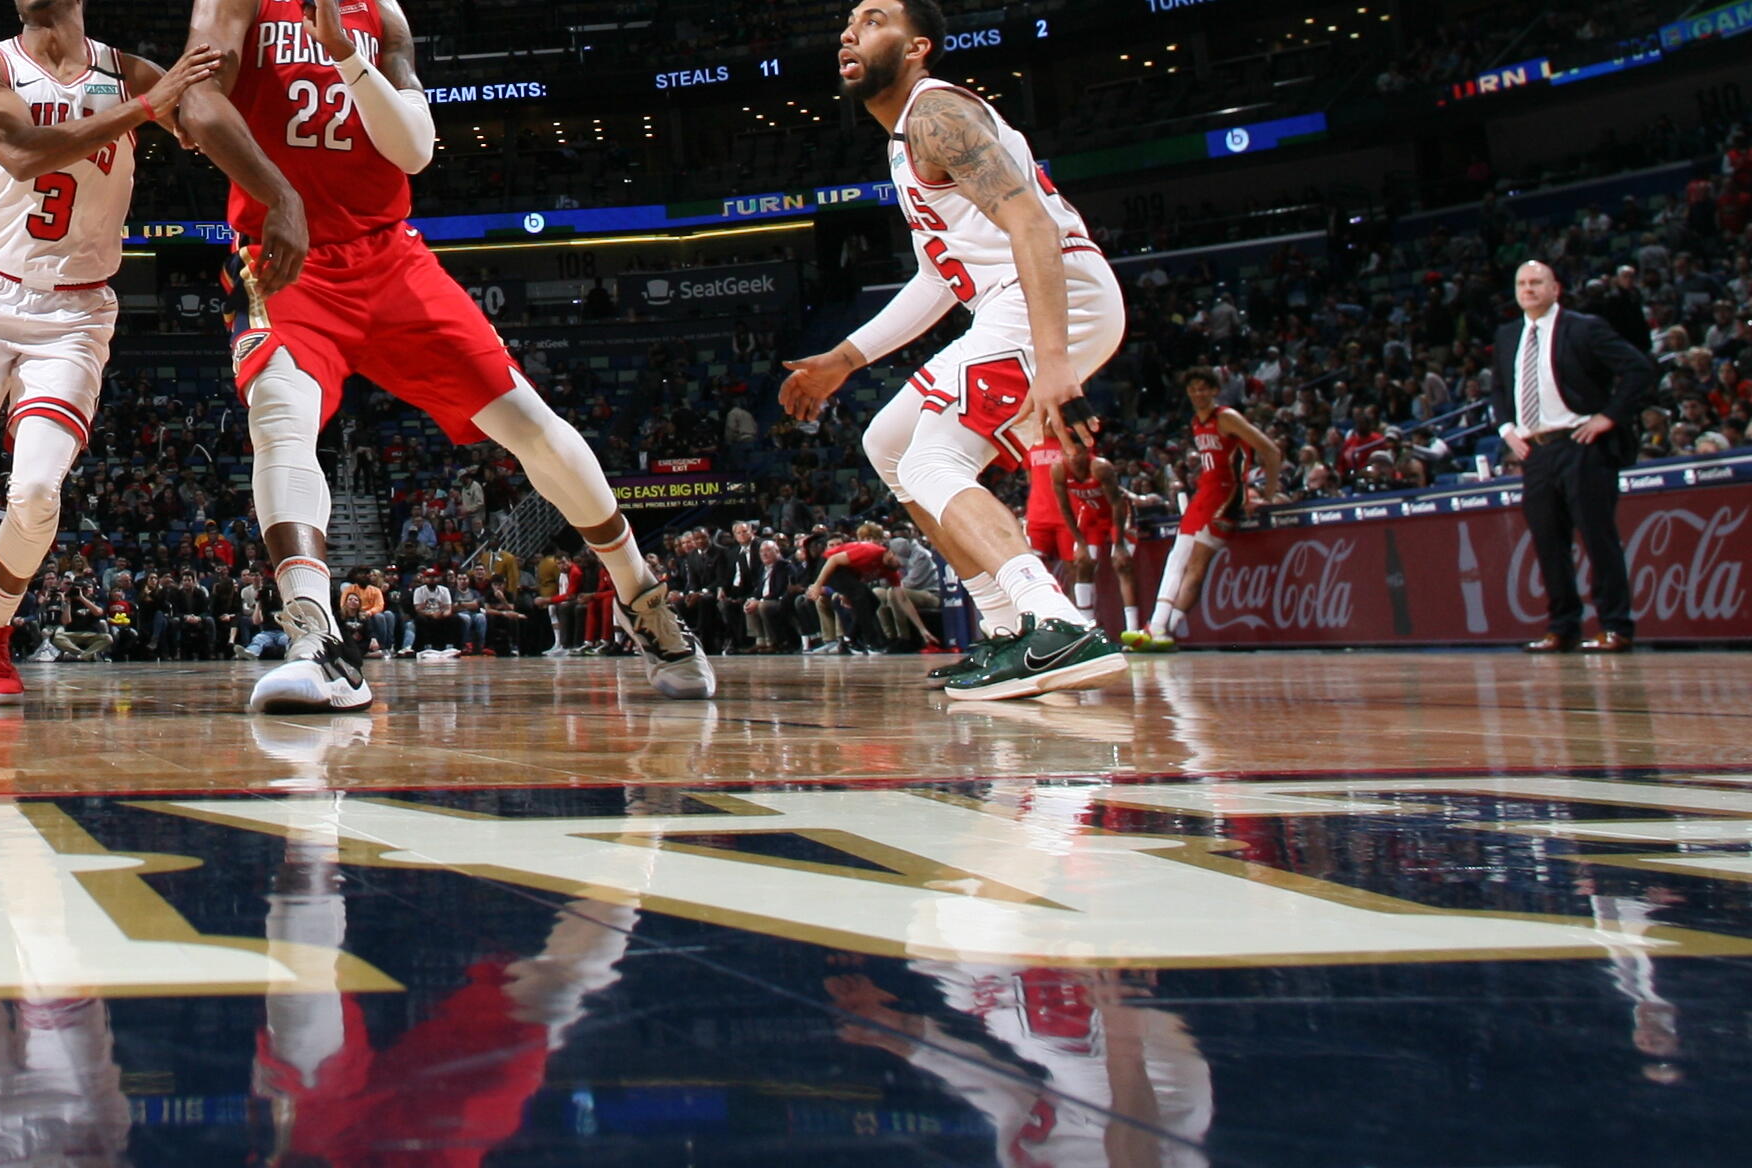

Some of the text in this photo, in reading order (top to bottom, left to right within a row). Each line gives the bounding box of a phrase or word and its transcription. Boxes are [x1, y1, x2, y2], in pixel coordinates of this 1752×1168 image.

[944, 19, 1048, 52] OCKS 2
[655, 58, 780, 89] STEALS 11
[425, 81, 547, 104] TEAM STATS:
[286, 78, 354, 151] 22
[25, 170, 78, 242] 3
[817, 187, 863, 206] UP
[142, 224, 185, 238] UP
[554, 251, 596, 280] 108
[923, 236, 976, 303] 5
[679, 275, 776, 300] SeatGeek
[671, 464, 689, 473] EXIT
[669, 484, 692, 497] BIG
[1201, 537, 1356, 631] Coca-Cola
